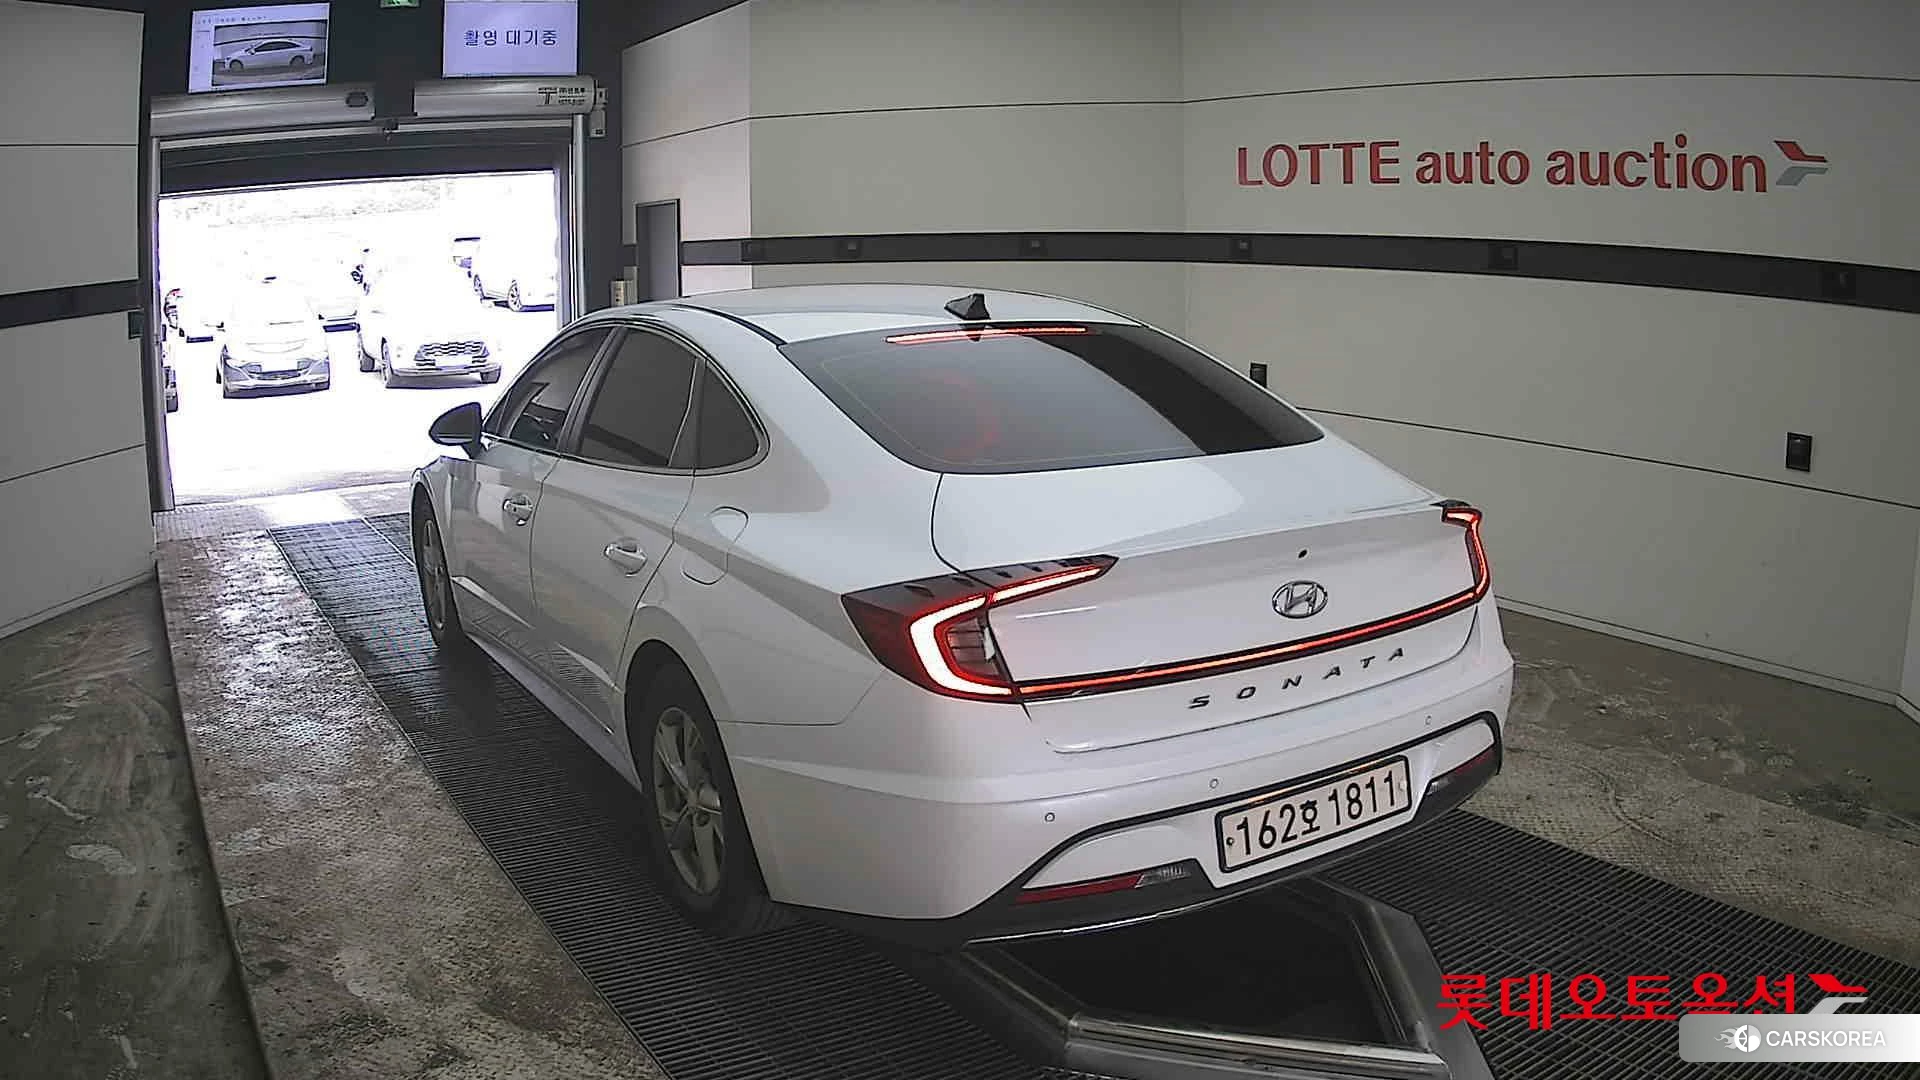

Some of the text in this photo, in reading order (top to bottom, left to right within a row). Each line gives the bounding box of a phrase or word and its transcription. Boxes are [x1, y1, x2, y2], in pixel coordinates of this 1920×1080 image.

[506, 29, 557, 47] 대기중
[1237, 134, 1768, 193] LOTTE auto auction
[1187, 647, 1407, 710] SONATA
[1236, 769, 1395, 856] 162호 1811
